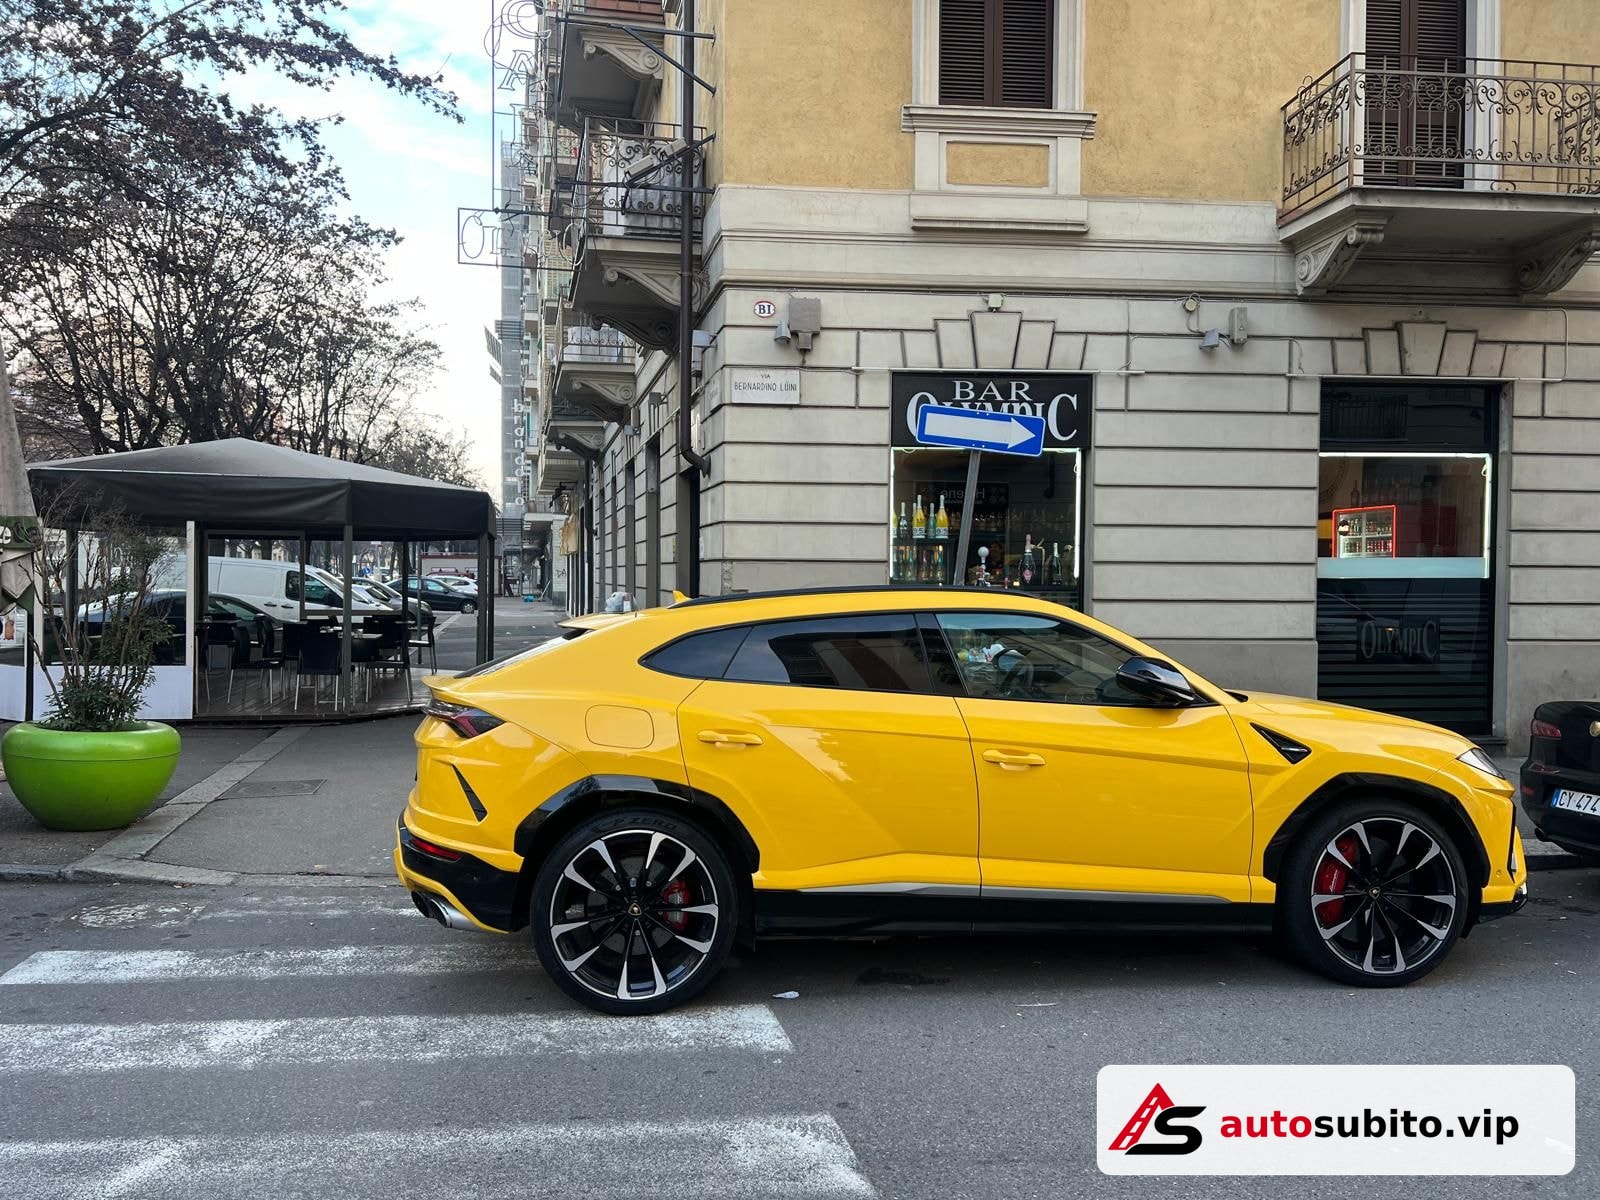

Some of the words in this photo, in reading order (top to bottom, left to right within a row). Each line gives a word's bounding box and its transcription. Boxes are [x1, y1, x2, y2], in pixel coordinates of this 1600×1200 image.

[734, 381, 777, 392] BERNARDINO
[952, 380, 1033, 401] BAR
[1361, 619, 1437, 659] OLYMPIC
[1558, 791, 1575, 808] CY
[628, 817, 678, 830] ZERO
